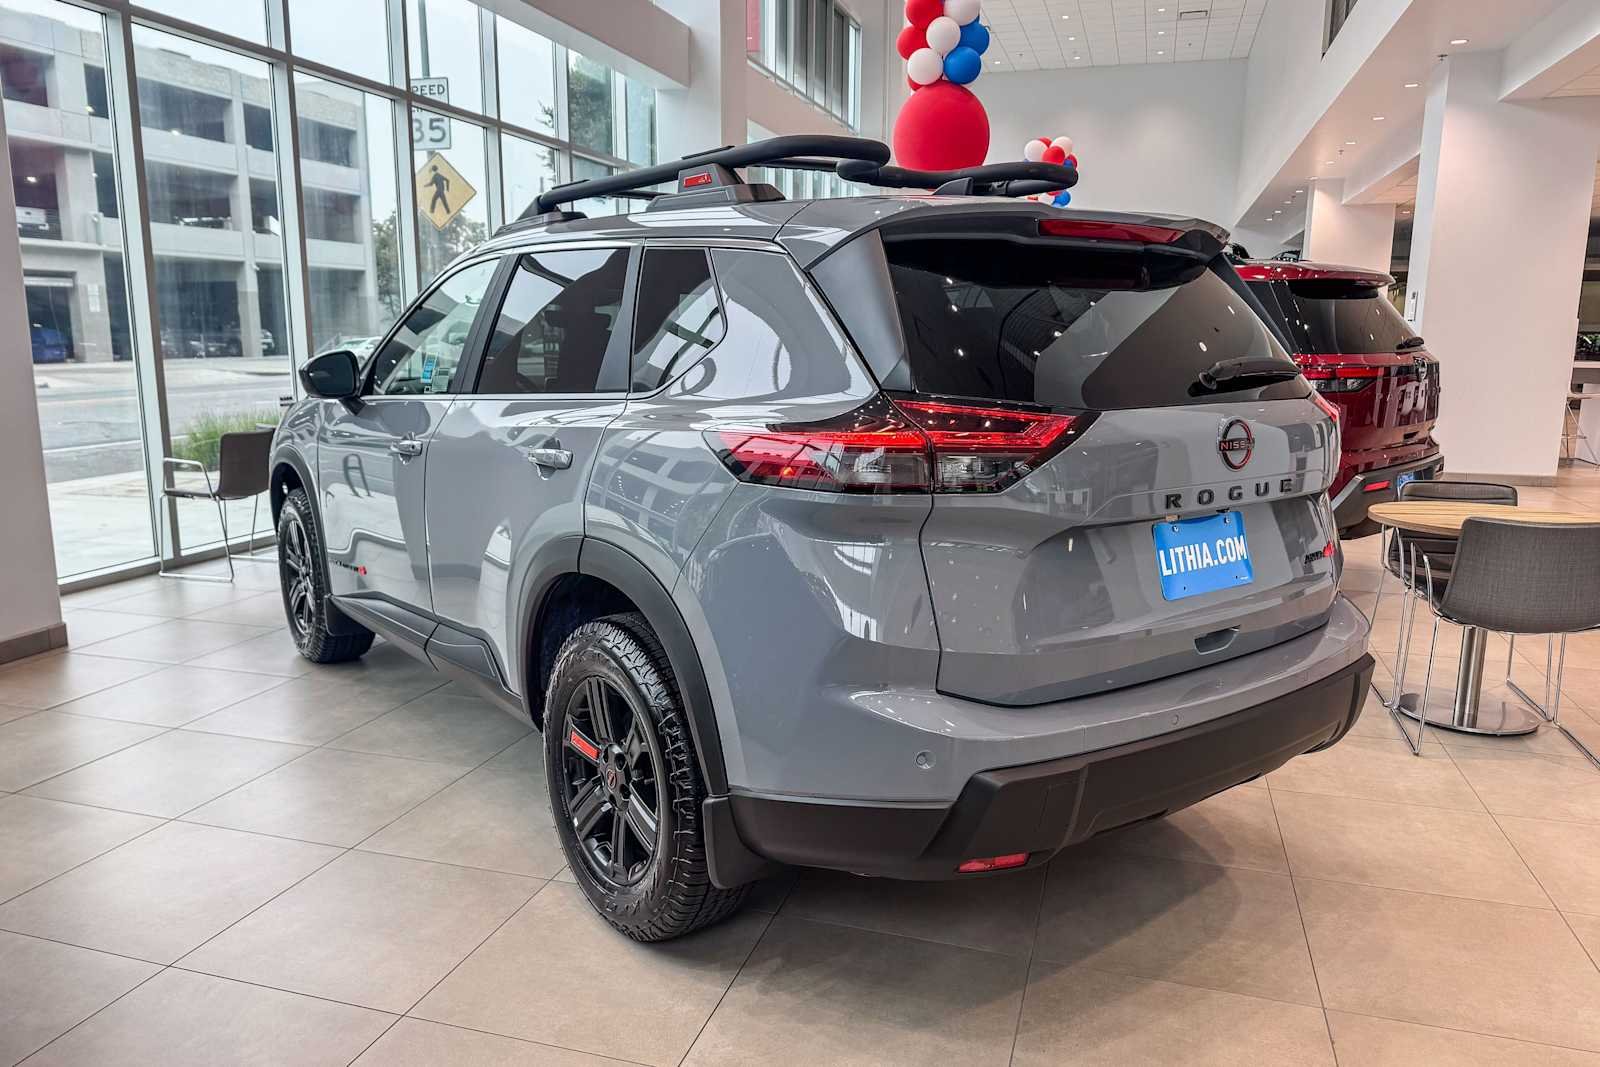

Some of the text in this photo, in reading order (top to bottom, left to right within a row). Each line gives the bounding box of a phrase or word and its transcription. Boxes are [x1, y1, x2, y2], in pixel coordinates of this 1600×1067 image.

[411, 84, 446, 96] PEED
[1164, 478, 1292, 510] ROGUE
[1159, 534, 1248, 577] LITHIA.COM
